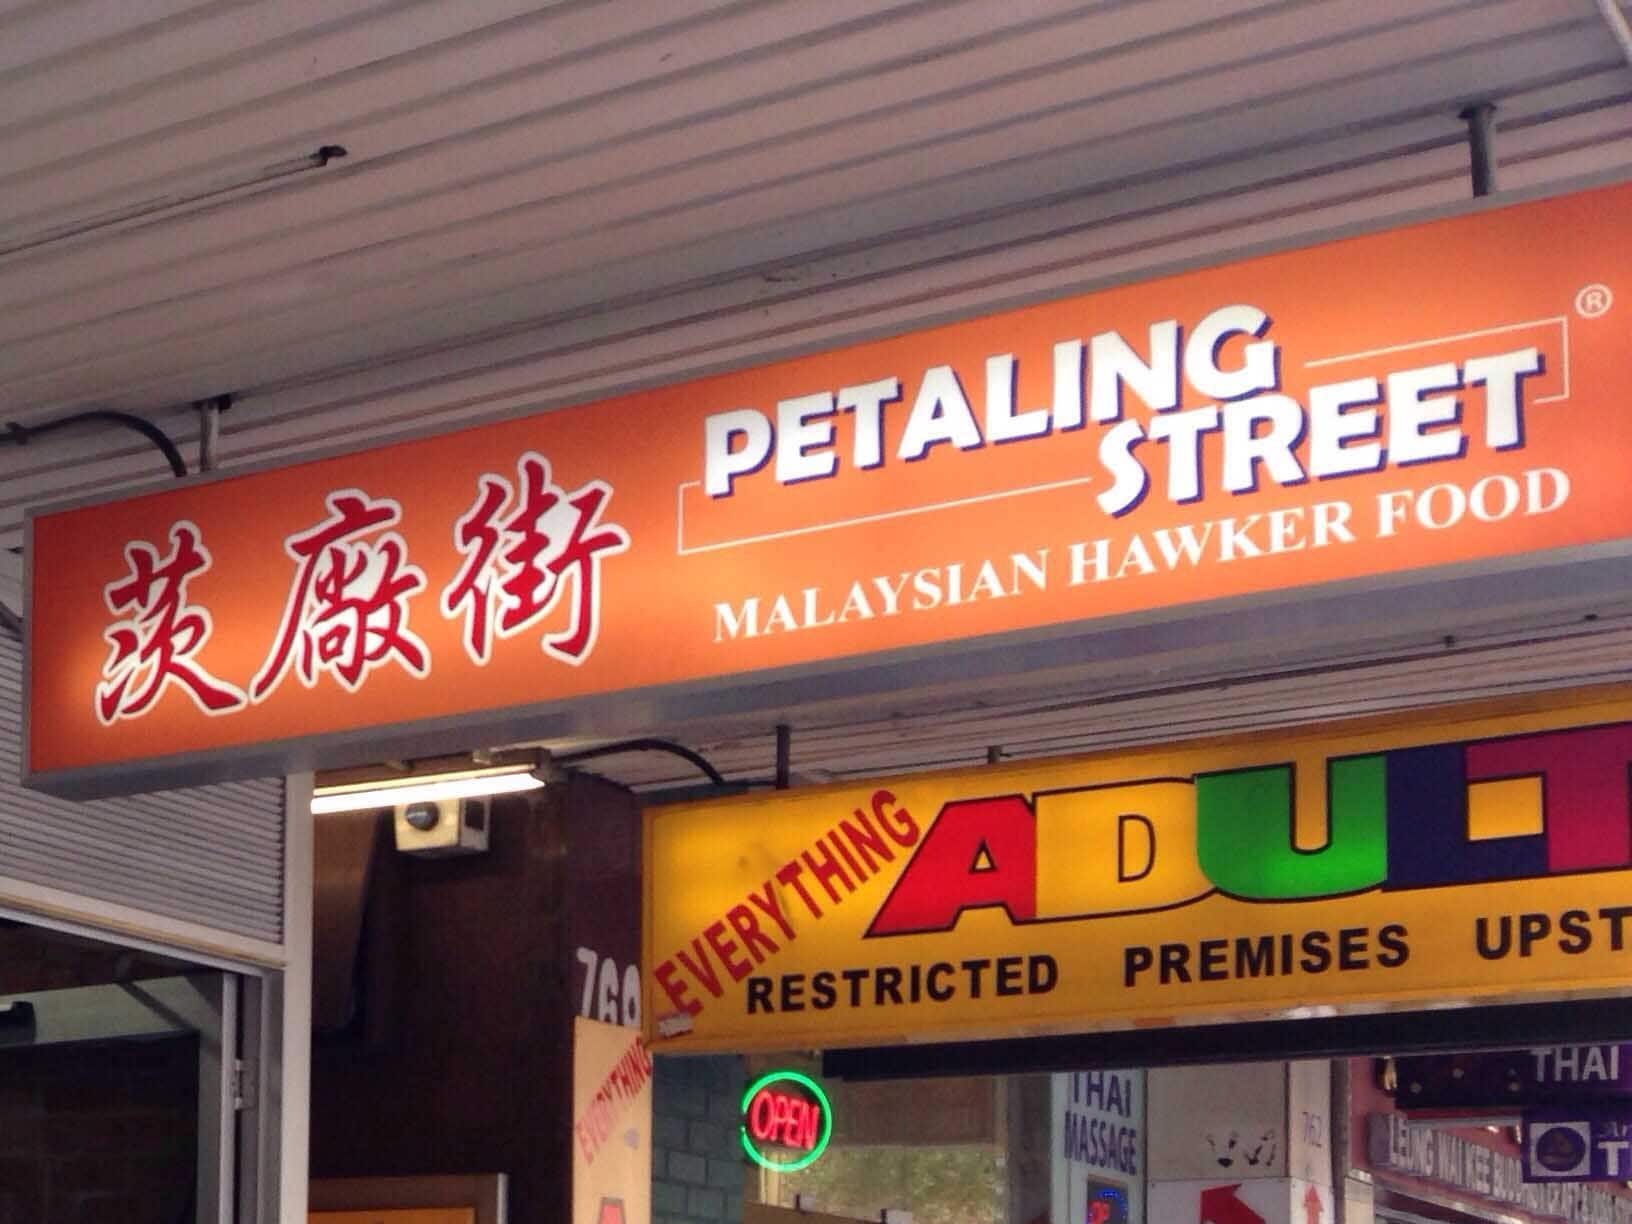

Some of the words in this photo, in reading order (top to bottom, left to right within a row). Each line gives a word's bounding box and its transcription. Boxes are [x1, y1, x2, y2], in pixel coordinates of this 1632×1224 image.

[704, 304, 1282, 500] PETALING
[1095, 347, 1548, 518] STREET
[95, 450, 630, 727] 茨廠街
[713, 549, 1049, 643] MALAYSIAN
[1067, 491, 1353, 588] HAWKER
[1375, 467, 1571, 538] FOOD
[655, 787, 922, 1021] EVERYTHING
[862, 721, 1632, 940] ADULT
[745, 954, 1061, 1017] RESTRICTED
[1123, 923, 1412, 988] PREMISES
[750, 1091, 820, 1151] OPEN
[1064, 1109, 1138, 1177] MASSAGE
[1069, 1071, 1133, 1120] THAI
[1529, 1045, 1620, 1083] THAI
